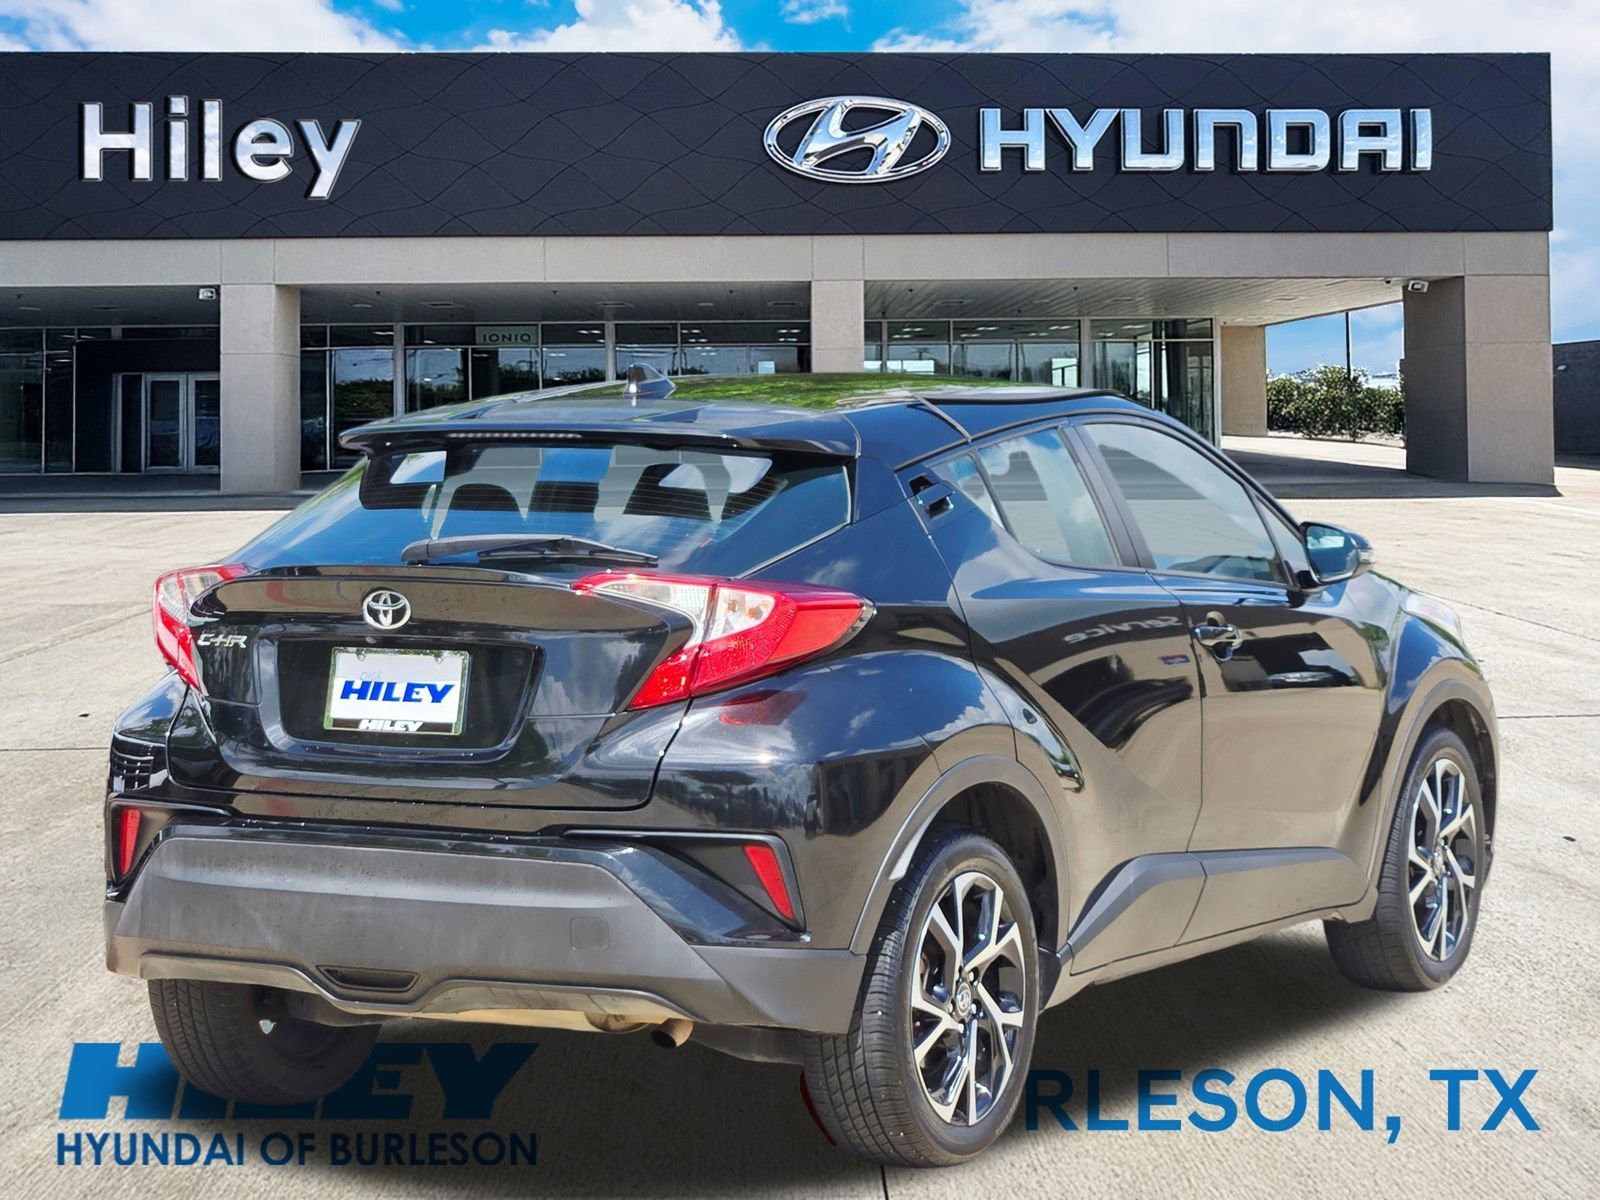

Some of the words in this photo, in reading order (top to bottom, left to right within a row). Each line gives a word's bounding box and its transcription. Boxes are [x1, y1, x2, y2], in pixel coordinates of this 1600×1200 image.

[81, 95, 362, 199] Hiley
[980, 107, 1433, 172] HYUNDAI
[340, 680, 455, 704] HILEY
[358, 719, 424, 732] HILEY
